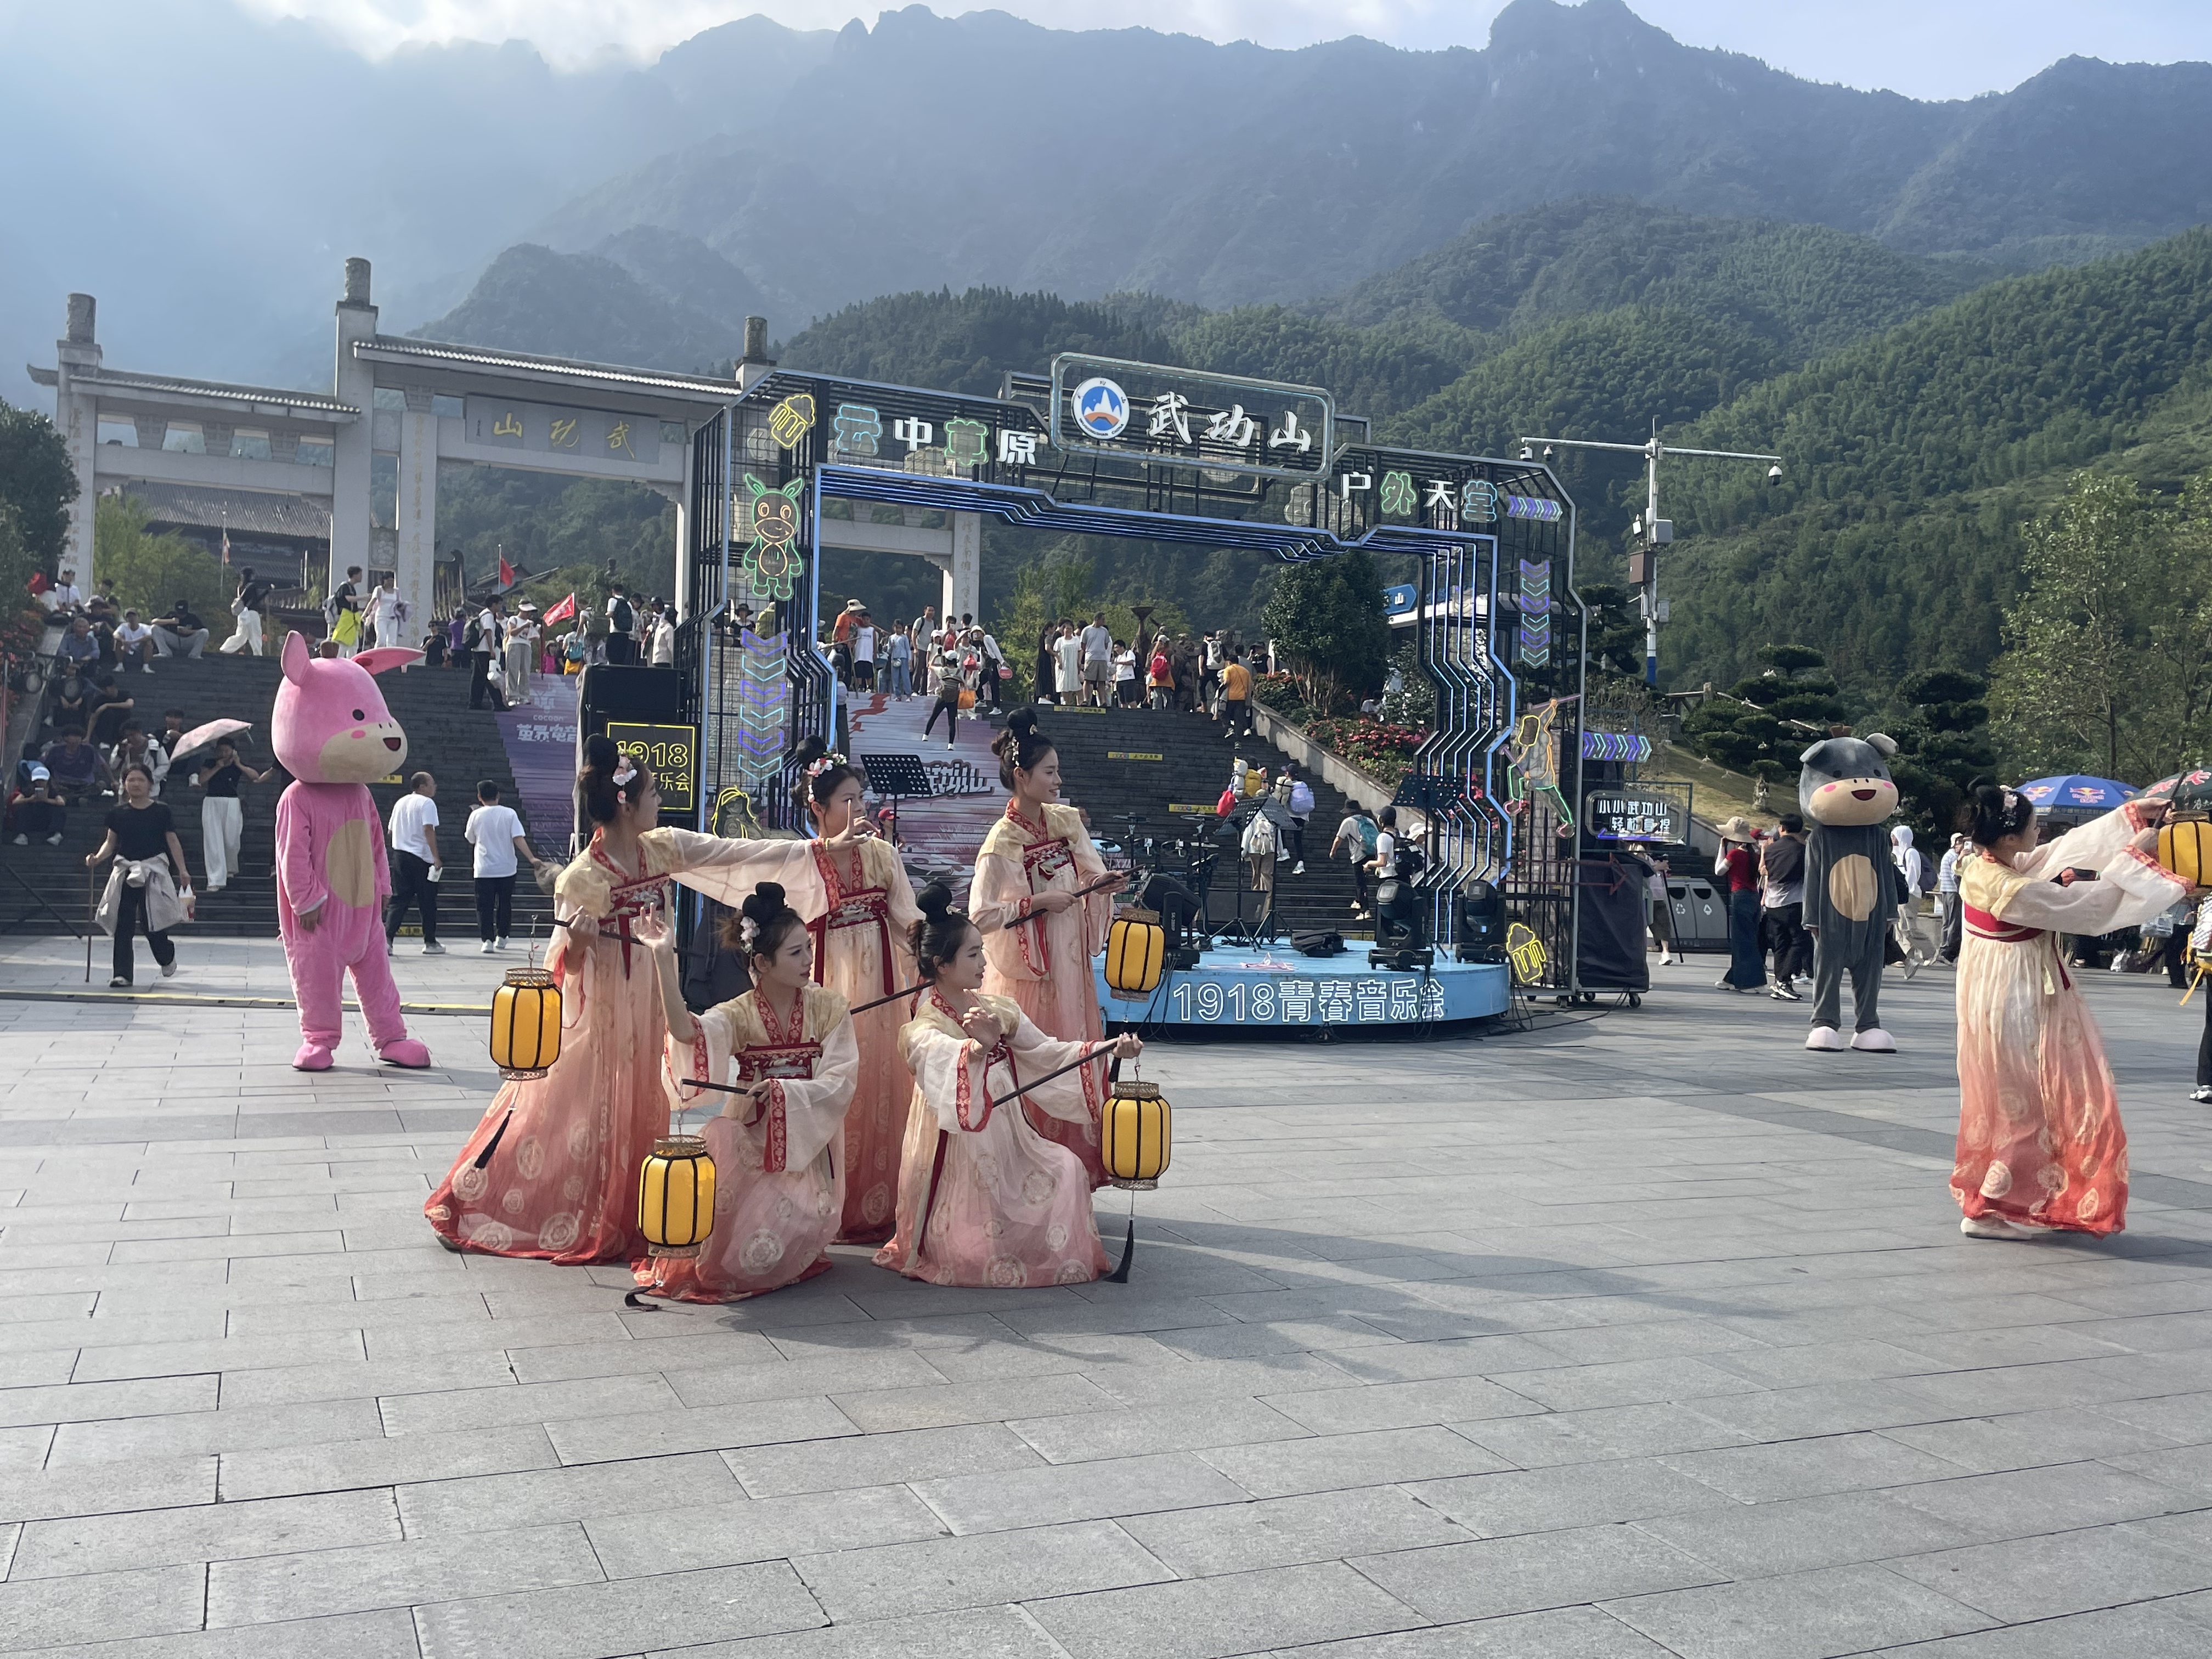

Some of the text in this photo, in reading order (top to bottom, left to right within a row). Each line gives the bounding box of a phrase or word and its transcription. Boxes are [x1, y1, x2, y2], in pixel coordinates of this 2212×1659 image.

[1146, 391, 1311, 455] 武功山
[1340, 470, 1498, 522] 户外天堂
[1598, 799, 1667, 816] 小小武功山
[1173, 978, 1444, 1023] 1918青春音乐会
